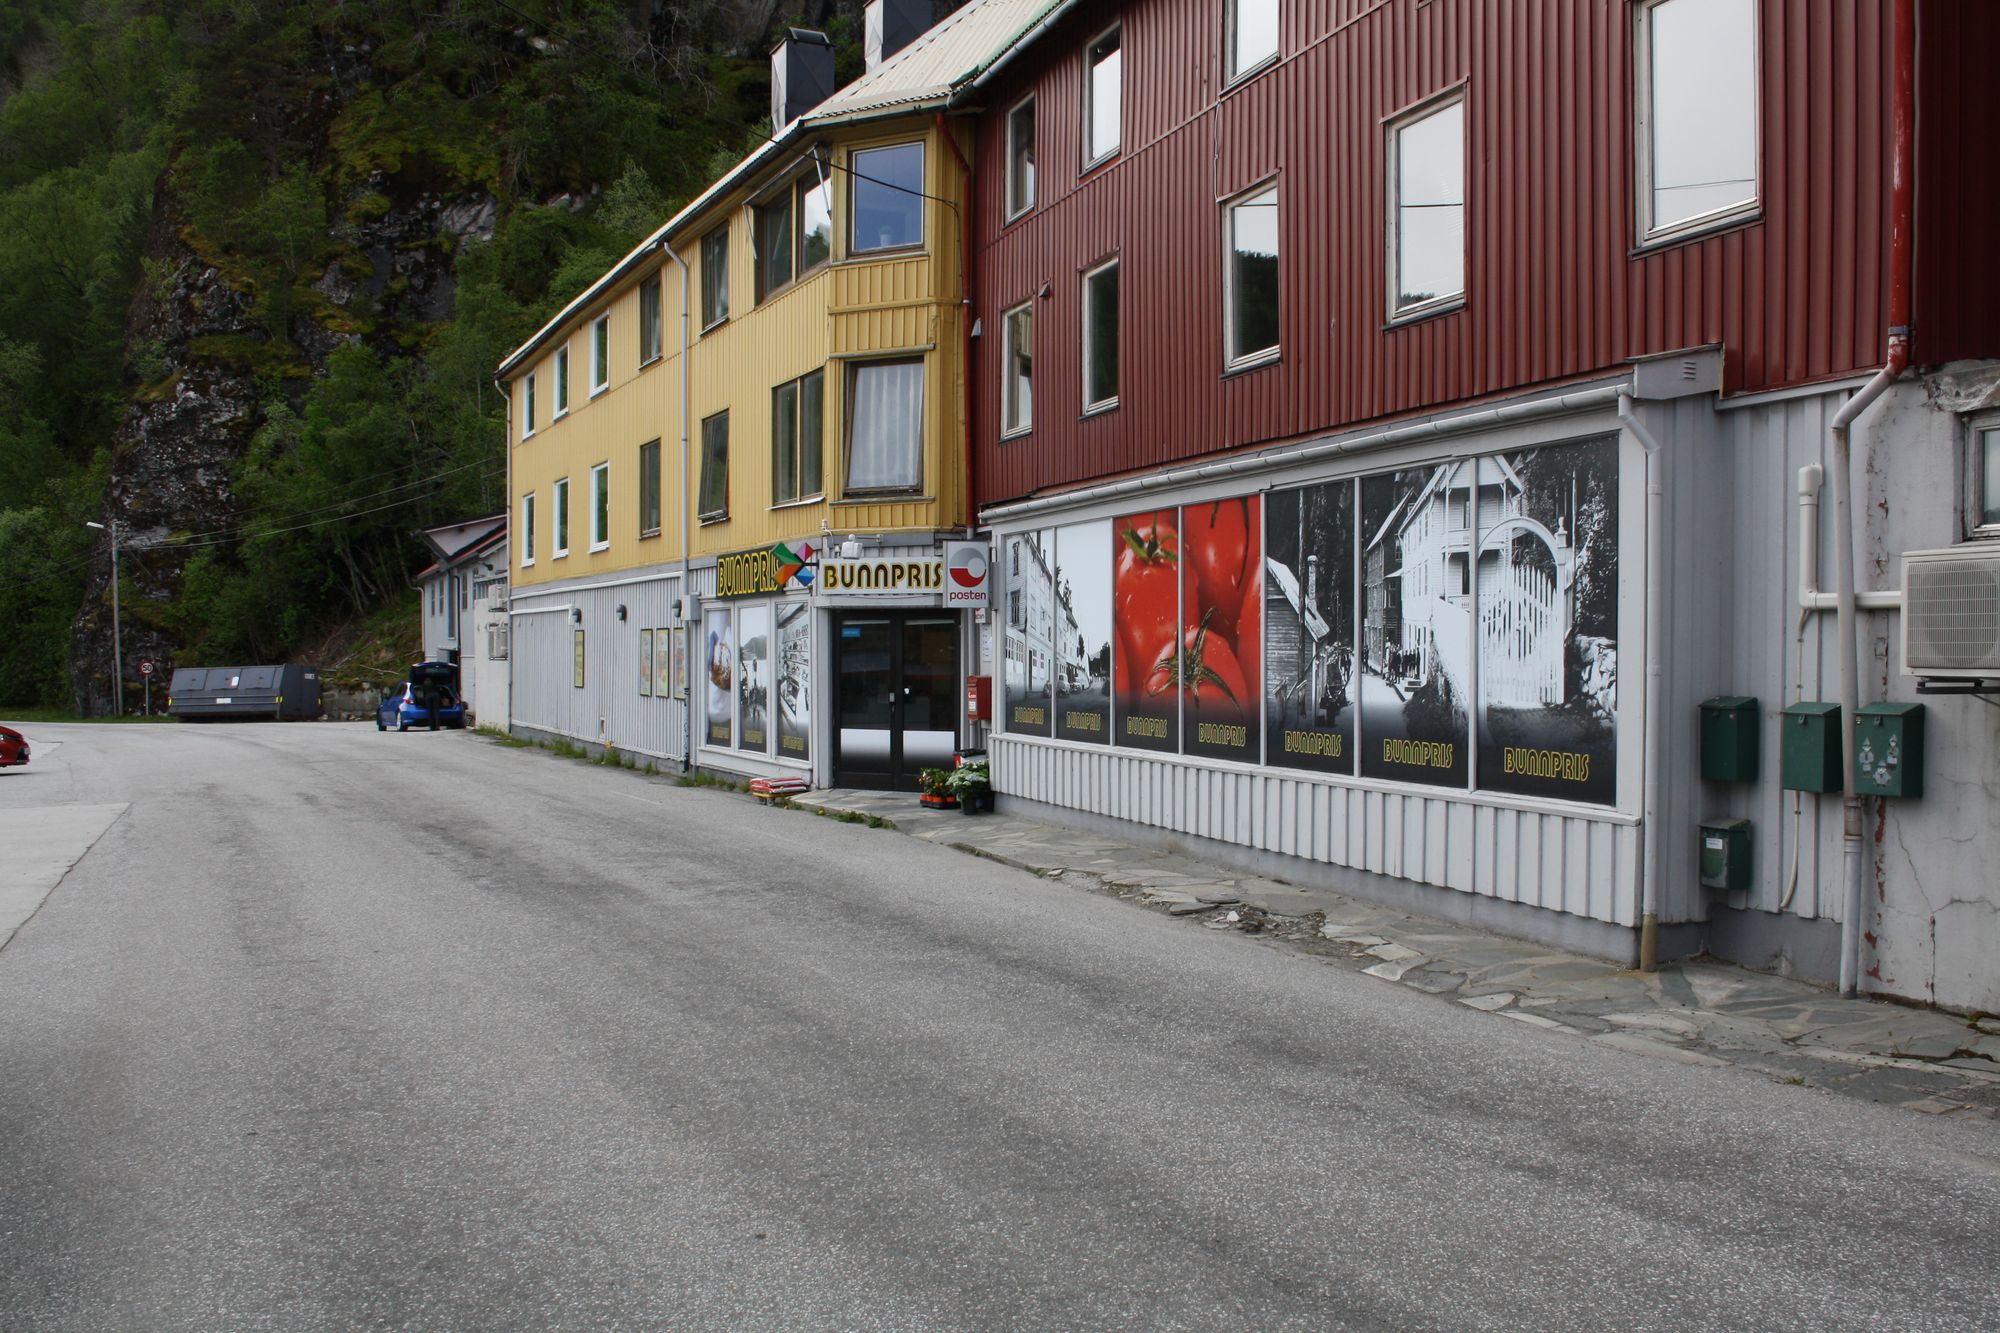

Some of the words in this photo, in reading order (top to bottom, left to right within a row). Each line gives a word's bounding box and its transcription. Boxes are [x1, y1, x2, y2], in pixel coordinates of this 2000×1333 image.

[823, 562, 943, 589] BUNNPRIS
[949, 590, 986, 602] posten
[1126, 716, 1167, 738] BUNNPRIS
[1199, 722, 1246, 747] BUNNPRIS
[1284, 730, 1342, 757] BUNNPRIS
[1383, 738, 1453, 768] BUNNPRIS
[1504, 747, 1589, 781] BUNNPRIS
